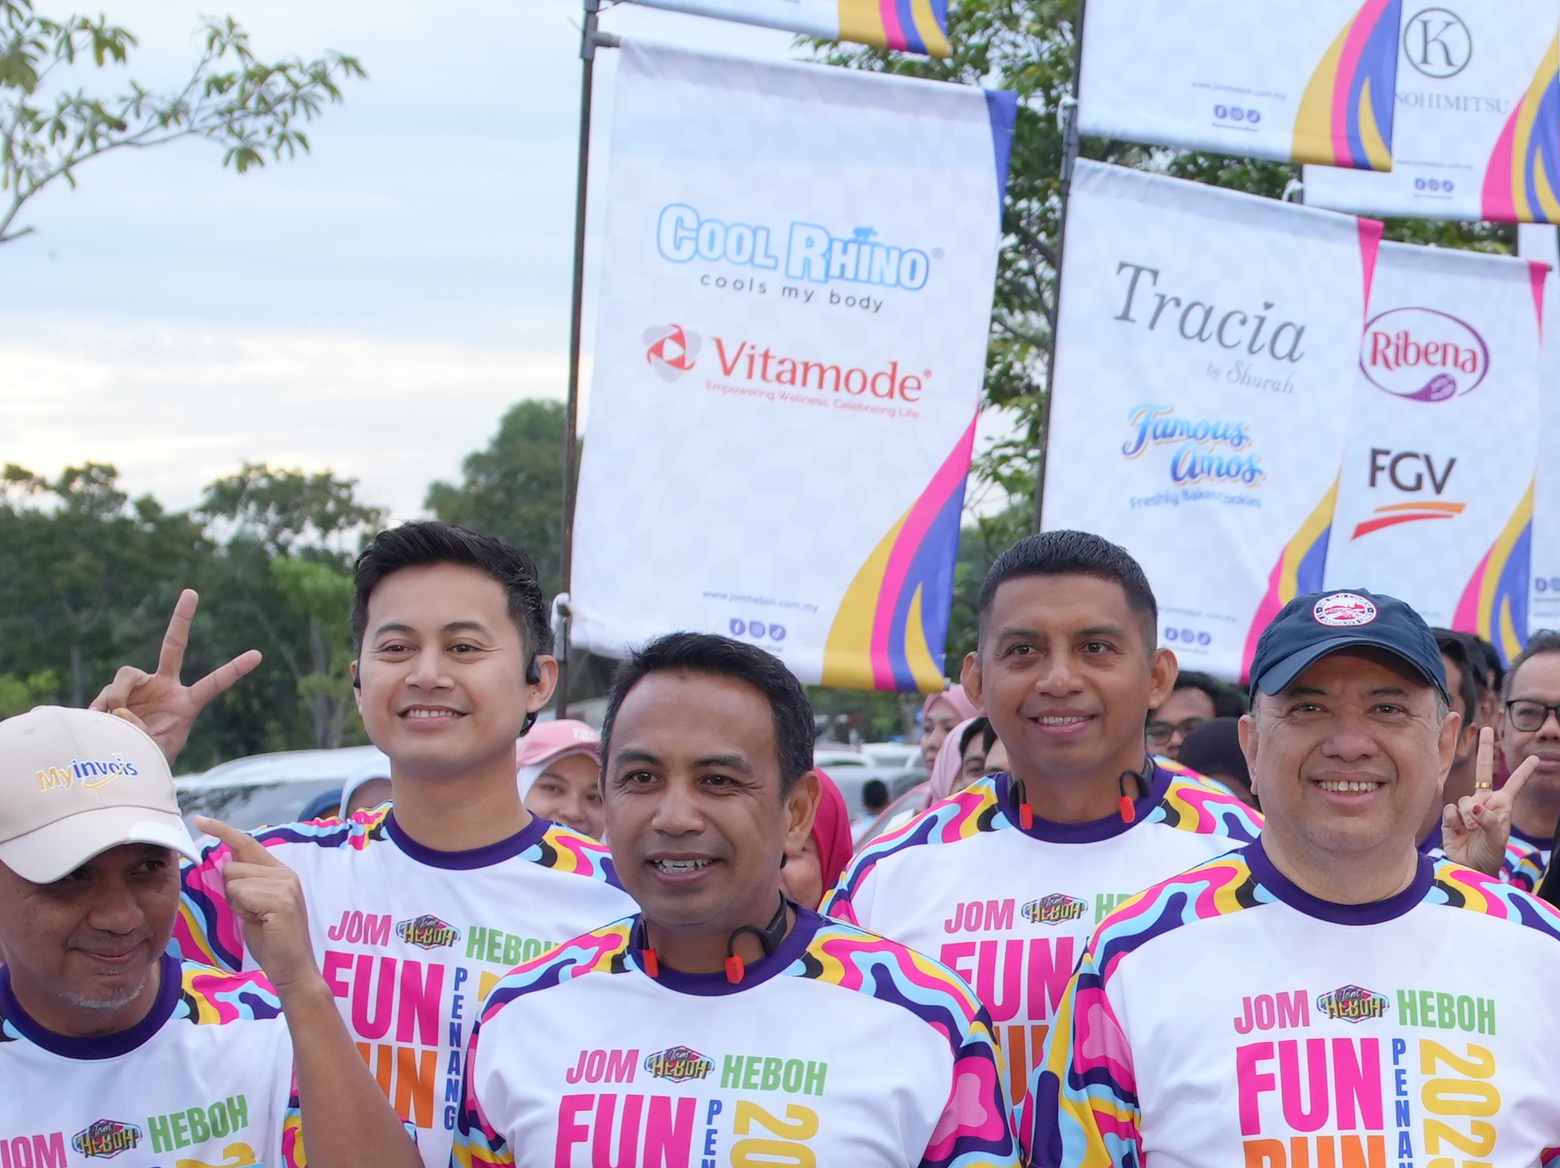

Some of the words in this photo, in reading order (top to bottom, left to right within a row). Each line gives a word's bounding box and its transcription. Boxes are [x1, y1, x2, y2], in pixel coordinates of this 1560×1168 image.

[1417, 19, 1458, 68] K
[1394, 91, 1510, 114] NOHIMITSU
[657, 203, 778, 270] COOL
[785, 220, 929, 291] RHINO
[700, 272, 767, 294] cools
[782, 285, 814, 303] my
[829, 290, 883, 313] body
[1113, 261, 1306, 363] Tracia
[710, 336, 923, 402] Vitamode
[1226, 359, 1295, 393] Shurah
[1370, 330, 1479, 374] Ribena
[706, 380, 775, 401] Empowering
[833, 398, 895, 418] Celebrating
[1122, 403, 1253, 459] Famous
[1368, 447, 1457, 495] FGV
[328, 910, 392, 947] JOM
[944, 898, 1015, 934] JOM
[322, 950, 445, 1047] FUN
[940, 937, 1074, 1022] FUN
[1234, 989, 1310, 1035] JOM
[1396, 989, 1496, 1036] HEBOH
[444, 967, 468, 1131] PENANG
[566, 1049, 640, 1084] JOM
[720, 1055, 828, 1096] HEBOH
[1236, 1037, 1384, 1137] FUN
[147, 1094, 249, 1154] HEBOH
